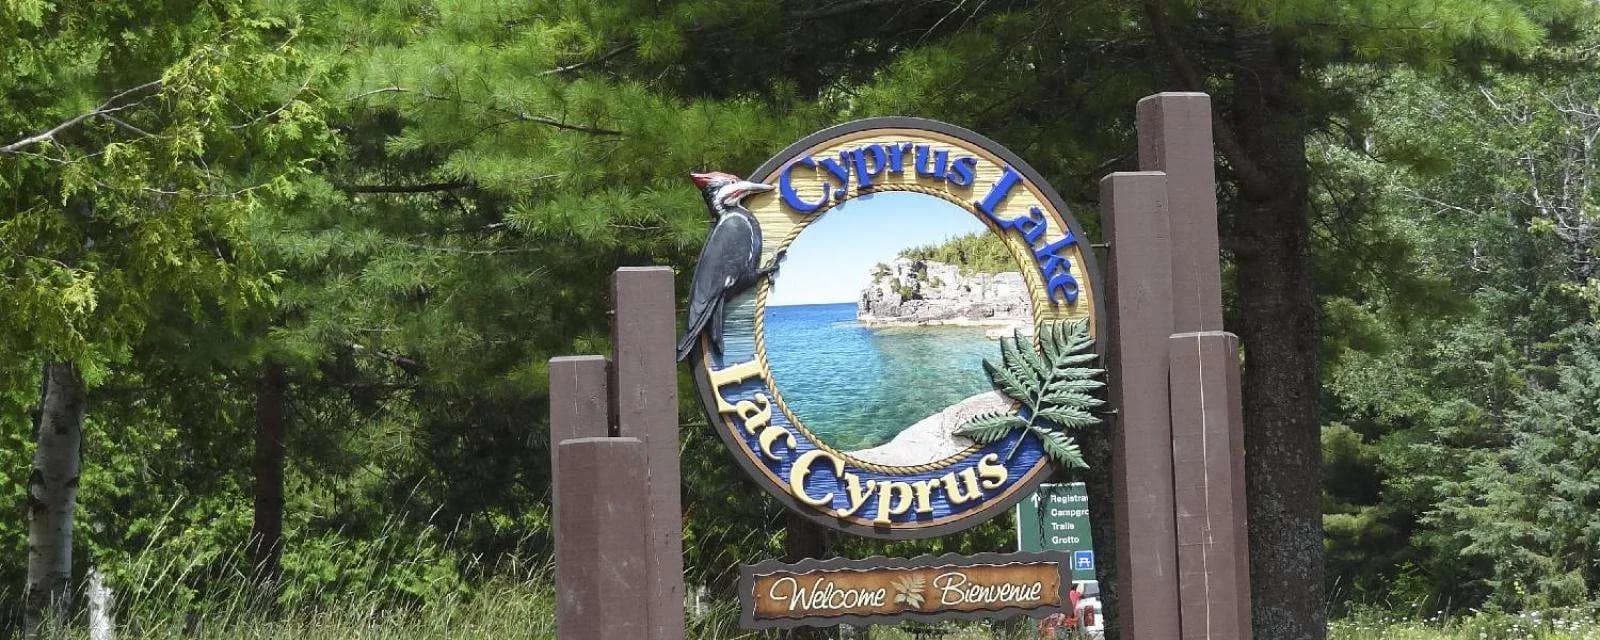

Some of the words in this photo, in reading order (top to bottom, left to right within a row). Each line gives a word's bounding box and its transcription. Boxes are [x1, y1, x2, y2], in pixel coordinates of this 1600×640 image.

[778, 141, 978, 214] Cyprus
[974, 164, 1079, 307] Lake
[708, 354, 797, 461] Lac
[789, 449, 1009, 525] Cyprus
[1051, 522, 1075, 531] Trails
[1051, 536, 1080, 545] Grotto
[769, 576, 886, 611] Welcome
[933, 571, 1042, 606] Bienvenue
